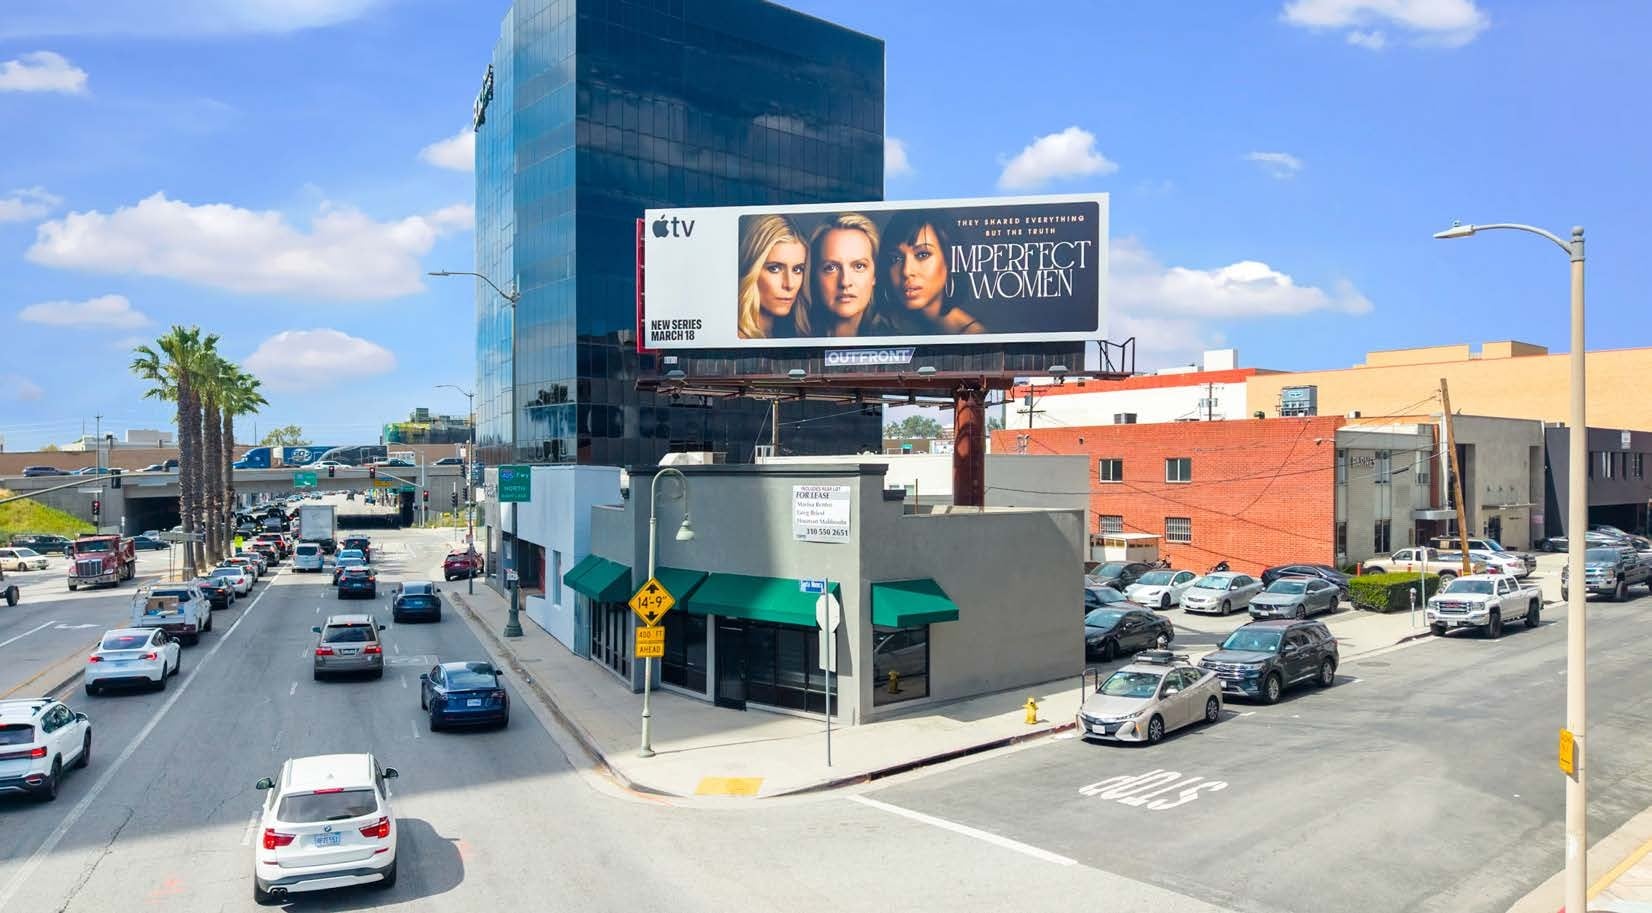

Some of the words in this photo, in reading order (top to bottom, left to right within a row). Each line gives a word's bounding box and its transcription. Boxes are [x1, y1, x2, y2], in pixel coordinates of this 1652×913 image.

[957, 219, 979, 227] THEY
[985, 218, 1020, 226] SHARED
[1026, 215, 1085, 224] EVERYTHING
[951, 240, 1091, 273] IMPERFECT
[968, 268, 1073, 299] WOMEN
[651, 320, 670, 330] NEW
[672, 319, 702, 330] SERIES
[651, 331, 683, 341] MARCH
[685, 330, 695, 341] 18
[516, 472, 528, 480] Fwy
[1078, 769, 1229, 810] STOP
